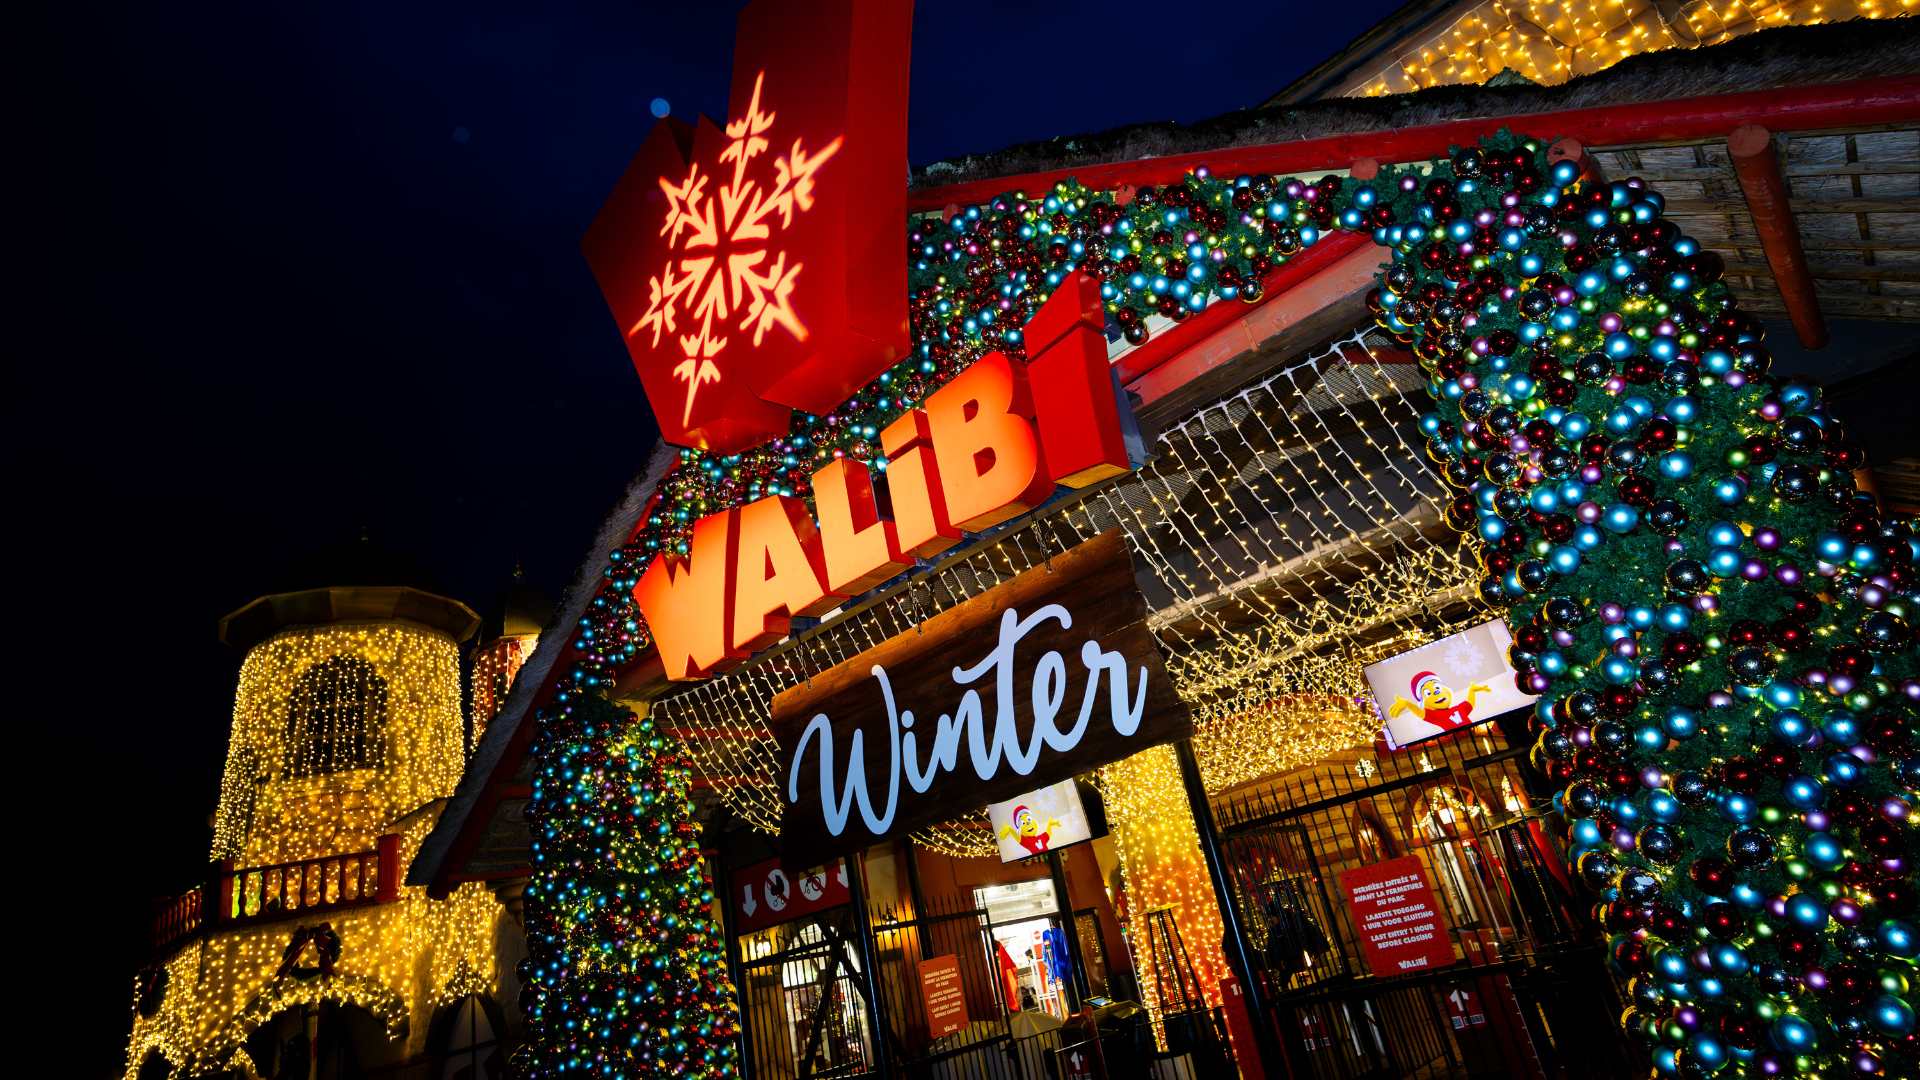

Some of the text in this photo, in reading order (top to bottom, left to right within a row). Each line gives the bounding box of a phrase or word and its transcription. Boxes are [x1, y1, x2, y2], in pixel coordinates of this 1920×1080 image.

[788, 604, 1149, 837] Winter
[1354, 883, 1424, 903] AVANT LA FERMETURE
[1387, 895, 1406, 904] PARC
[1365, 904, 1425, 921] LAATSTE TOEGANG
[1367, 922, 1382, 930] UUR
[1382, 917, 1403, 927] VOOR
[1403, 911, 1434, 922] SLUITING
[1370, 933, 1387, 942] LAST
[1387, 929, 1408, 939] ENTRY
[1414, 924, 1435, 934] HOUR
[1377, 933, 1433, 949] BEFORE CLOSING
